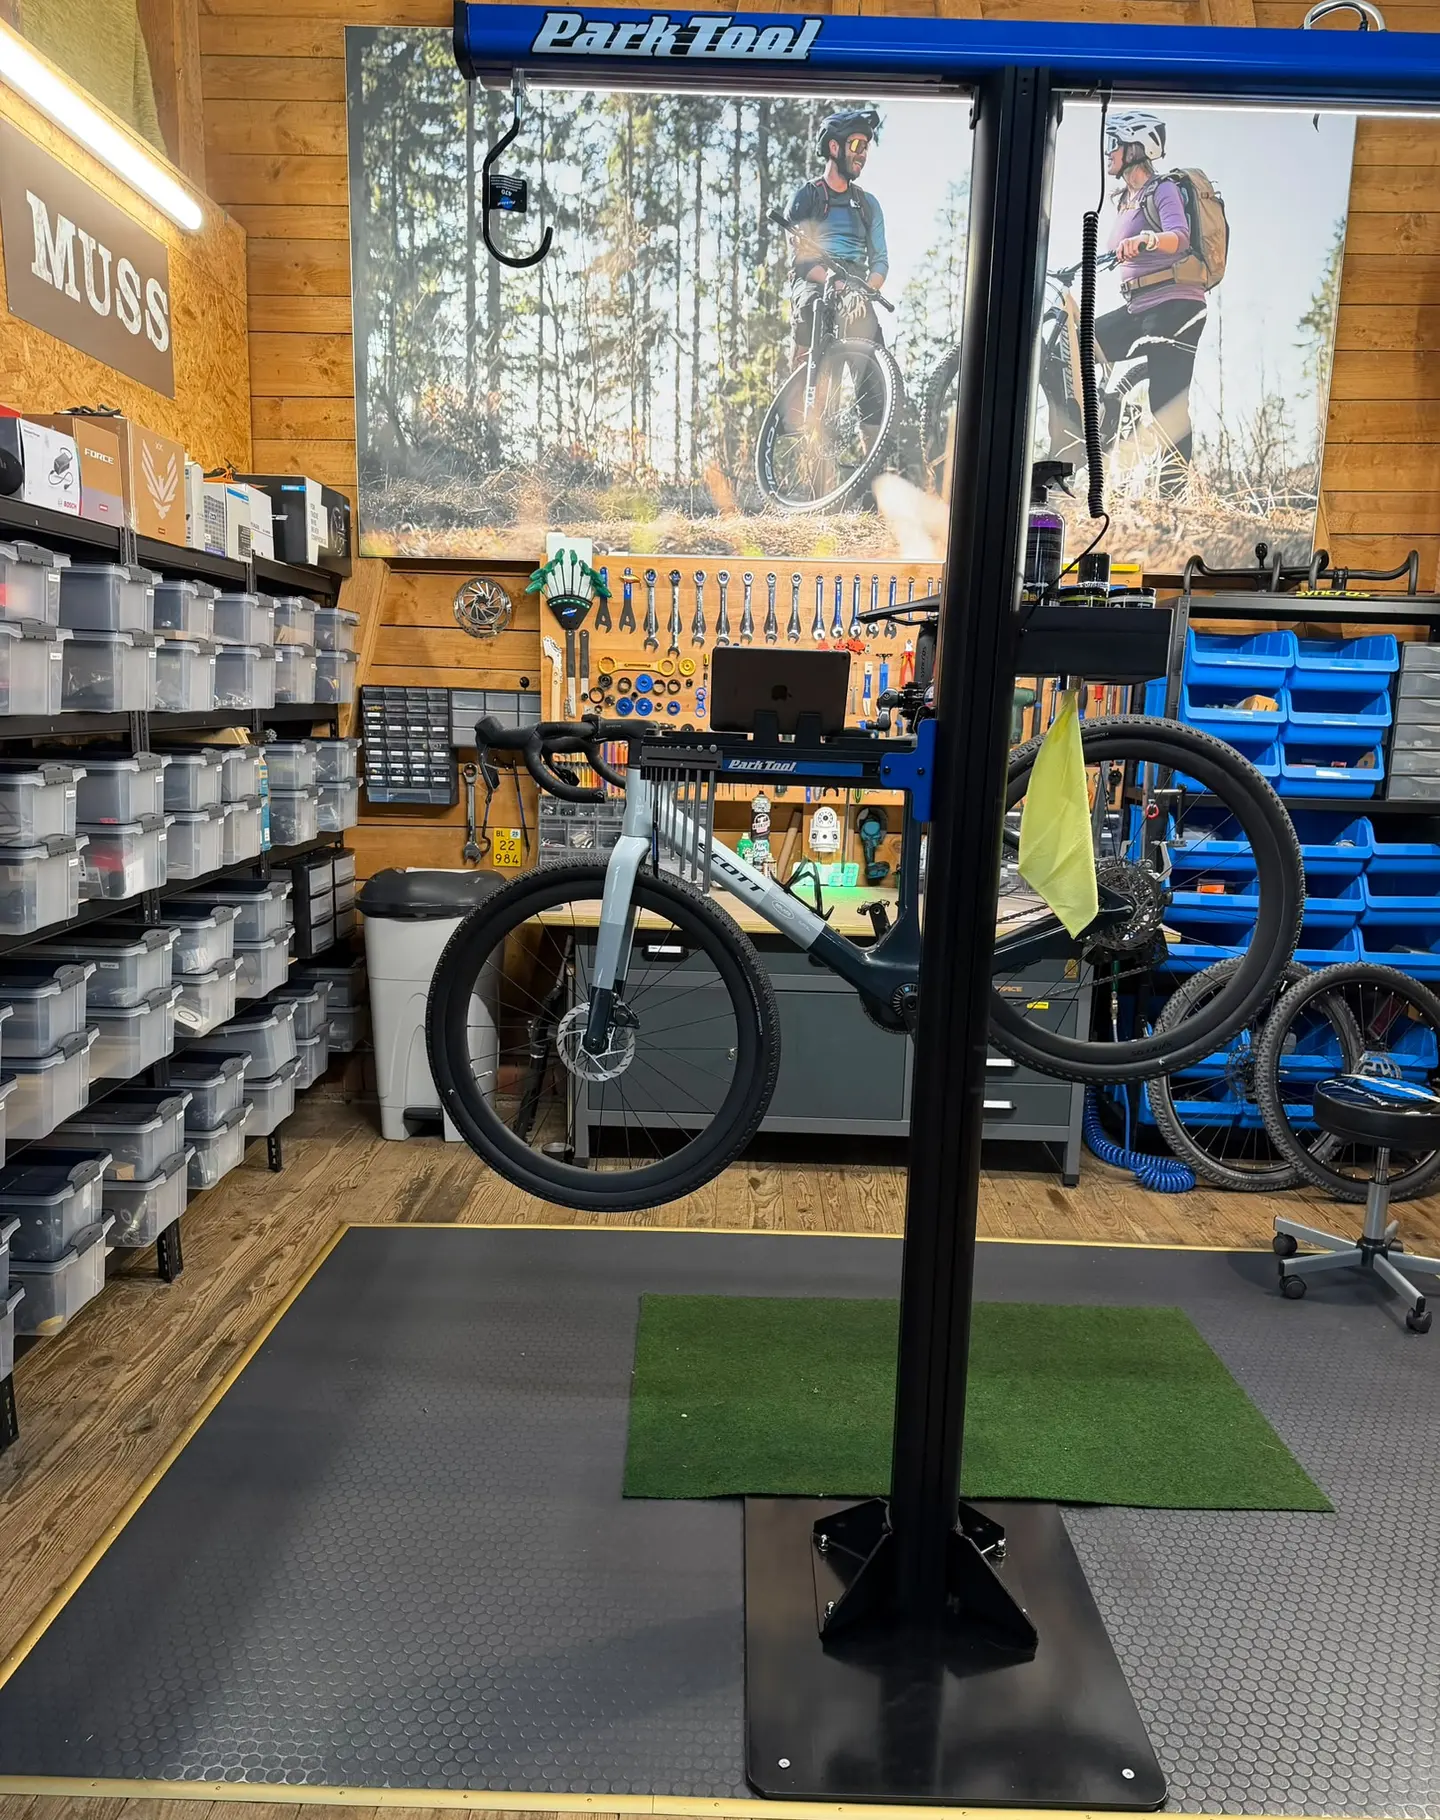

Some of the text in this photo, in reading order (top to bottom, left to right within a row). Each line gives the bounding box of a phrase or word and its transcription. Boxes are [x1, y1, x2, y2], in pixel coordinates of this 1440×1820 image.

[26, 189, 169, 352] MUSS
[84, 447, 115, 465] FORCE
[63, 500, 77, 510] BOSCH
[500, 840, 515, 850] 22
[495, 853, 519, 865] 984
